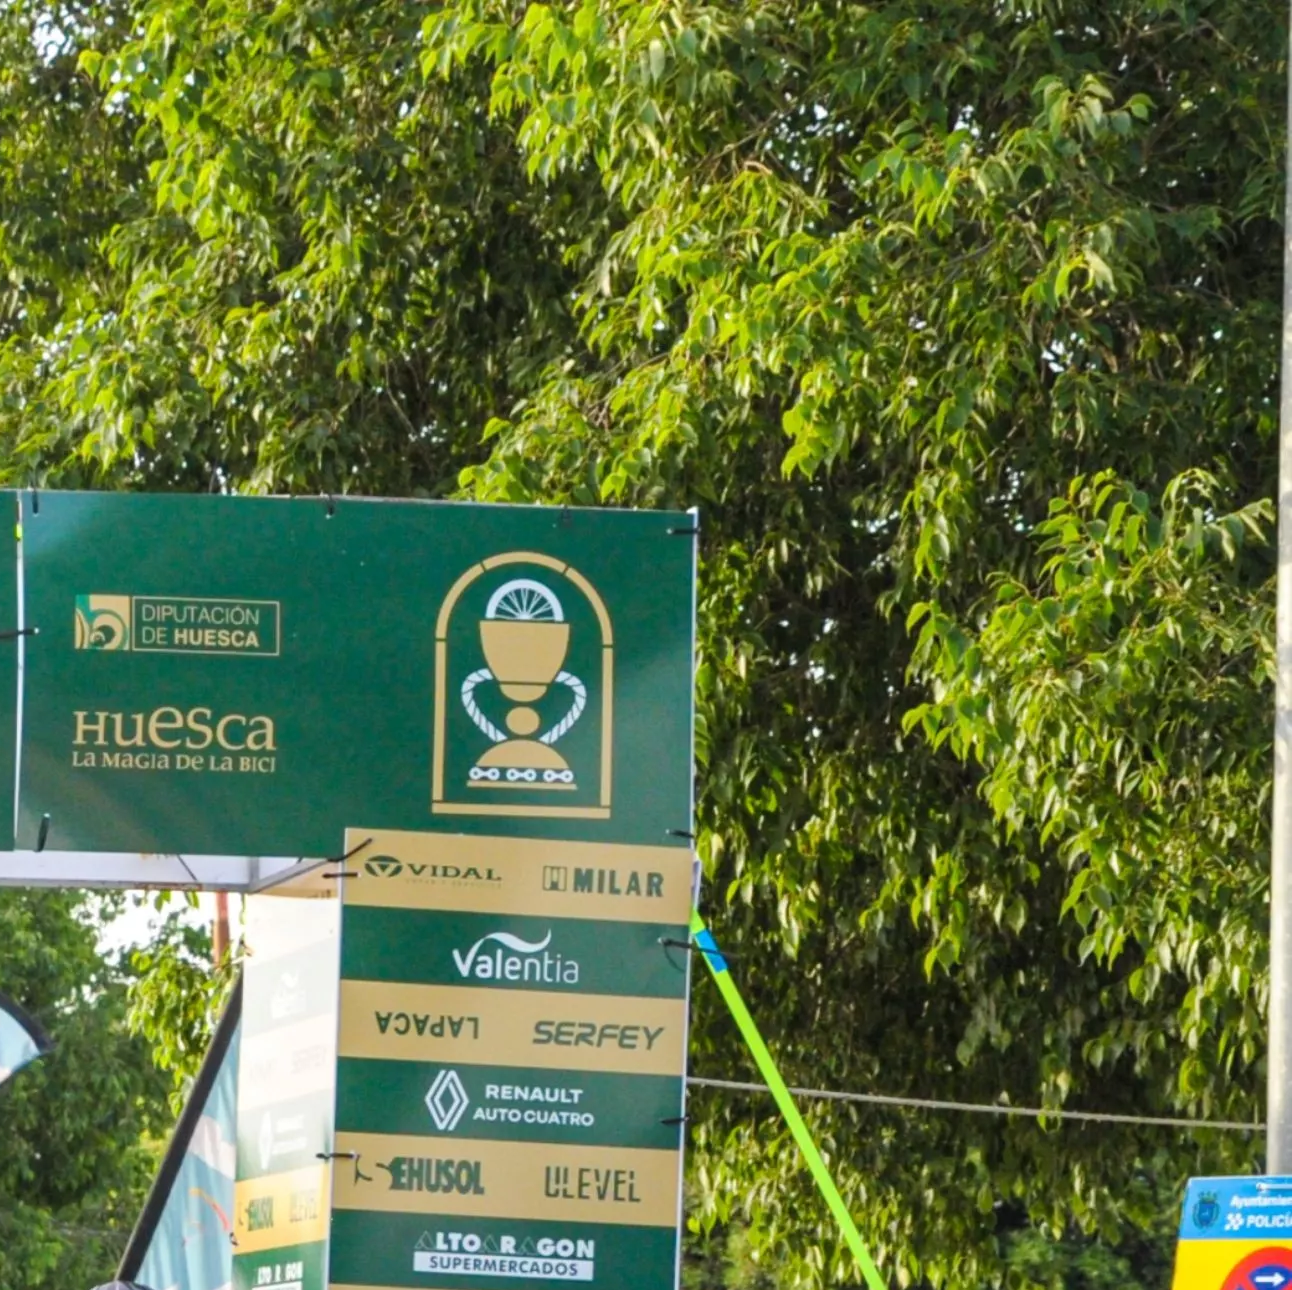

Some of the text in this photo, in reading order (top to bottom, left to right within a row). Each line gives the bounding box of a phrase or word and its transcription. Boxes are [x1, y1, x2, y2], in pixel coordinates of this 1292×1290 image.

[142, 603, 260, 625] DIPUTACIÓN
[142, 627, 260, 648] DE HUESCA
[71, 706, 277, 751] Huesca
[239, 756, 276, 773] BICI
[407, 863, 502, 881] VIDAL
[573, 867, 664, 897] MILAR
[452, 931, 579, 984] Valentia
[375, 1011, 479, 1039] LAPACA
[532, 1020, 664, 1051] SERFEY
[485, 1084, 584, 1104] RENAULT
[429, 1255, 578, 1277] SUPERMERCADOS
